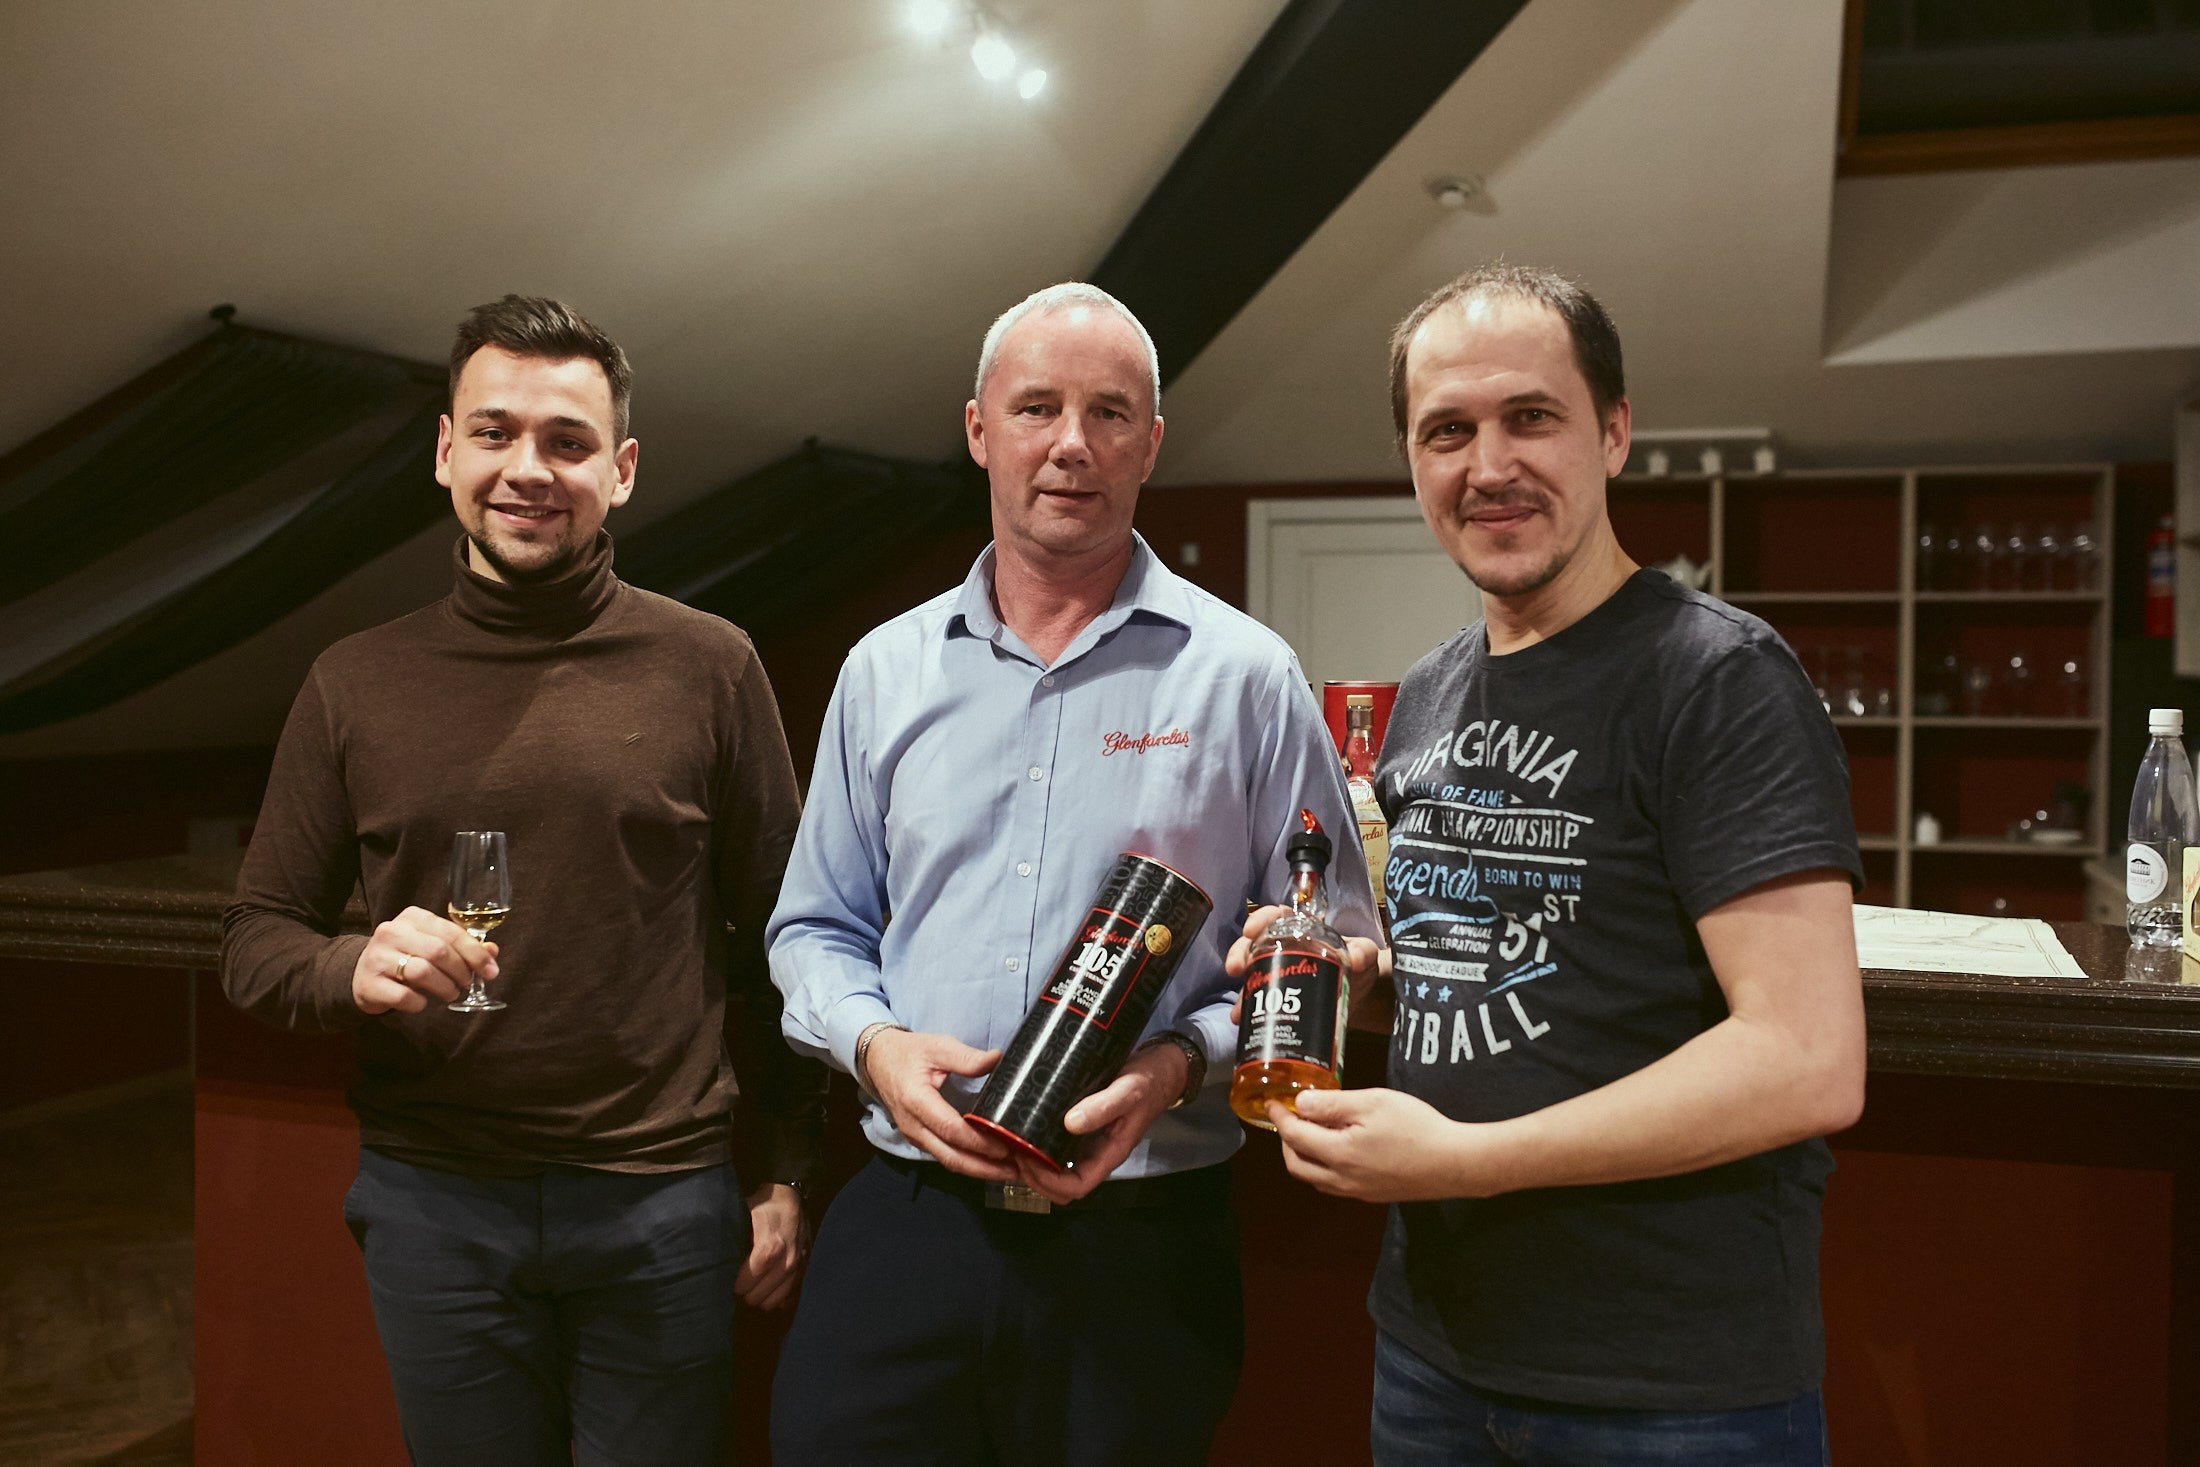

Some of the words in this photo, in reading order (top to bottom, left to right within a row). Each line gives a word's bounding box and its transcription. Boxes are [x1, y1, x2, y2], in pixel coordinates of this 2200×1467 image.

[1102, 728, 1190, 757] Glenfarclas
[1441, 784, 1466, 802] OF
[1467, 788, 1505, 808] FAME
[1441, 811, 1580, 850] CHAMPIONSHIP
[1485, 868, 1518, 886] BORN
[1523, 871, 1543, 888] TO
[1548, 874, 1581, 890] WIN
[1449, 923, 1493, 940] ANNUAL
[1499, 911, 1549, 963] 51
[1543, 894, 1581, 922] ST
[1073, 942, 1123, 980] 105
[1445, 963, 1480, 978] LEAGUE
[1252, 986, 1302, 1018] 105
